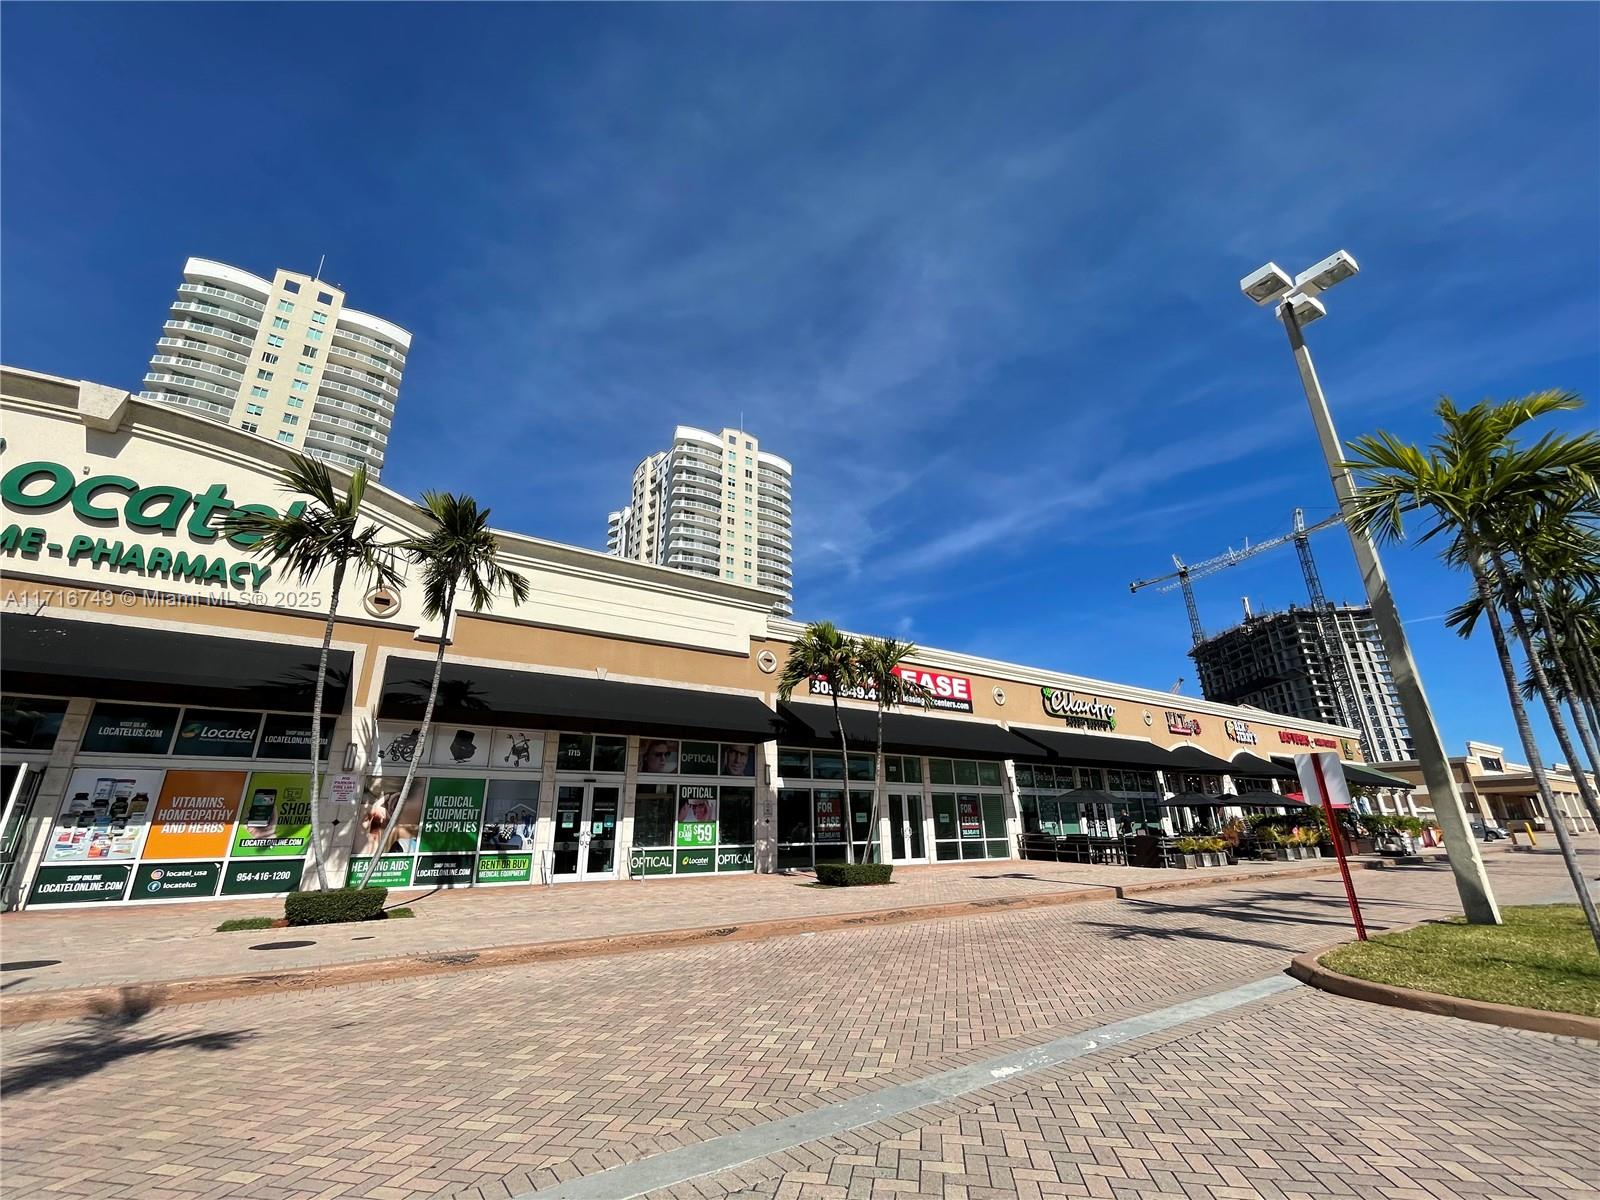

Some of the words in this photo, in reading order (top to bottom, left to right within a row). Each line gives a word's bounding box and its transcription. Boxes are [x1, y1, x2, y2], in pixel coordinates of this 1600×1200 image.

[0, 461, 306, 551] ocatel
[901, 670, 968, 699] EASE
[1051, 690, 1115, 717] Cilantro
[98, 726, 163, 738] LOCATELUS.COM
[200, 726, 256, 740] Locatel
[264, 735, 328, 745] LOCATELONLINOM
[682, 753, 717, 764] OPTICAL
[681, 786, 714, 799] OPTICAL
[172, 796, 226, 809] VITAMINS,
[434, 796, 474, 808] MEDICAL
[817, 801, 833, 813] FOR
[280, 802, 312, 816] SHOP
[960, 803, 973, 814] FOR
[158, 808, 234, 822] HOMEOPATHY
[426, 809, 480, 821] EQUIPMENT
[161, 823, 187, 834] AND
[188, 822, 225, 833] HERBS
[425, 823, 433, 833] &
[434, 821, 477, 833] SUPPLIES
[817, 816, 841, 828] LEASE
[241, 838, 302, 847] LOCATELONLINE.COM
[481, 860, 500, 870] RENT
[501, 860, 511, 870] OR
[512, 859, 527, 869] BUY
[631, 855, 672, 869] OPTICAL
[718, 853, 753, 865] OPTICAL
[351, 861, 389, 872] HEANG
[390, 860, 410, 870] AIDS
[236, 871, 291, 882] 954-416-1200
[417, 868, 471, 877] LOCATELONLINE.COM
[500, 869, 526, 877] EQUIPMENT
[38, 881, 124, 893] LOCATELONLINE.COM
[163, 881, 198, 889] locatelus
